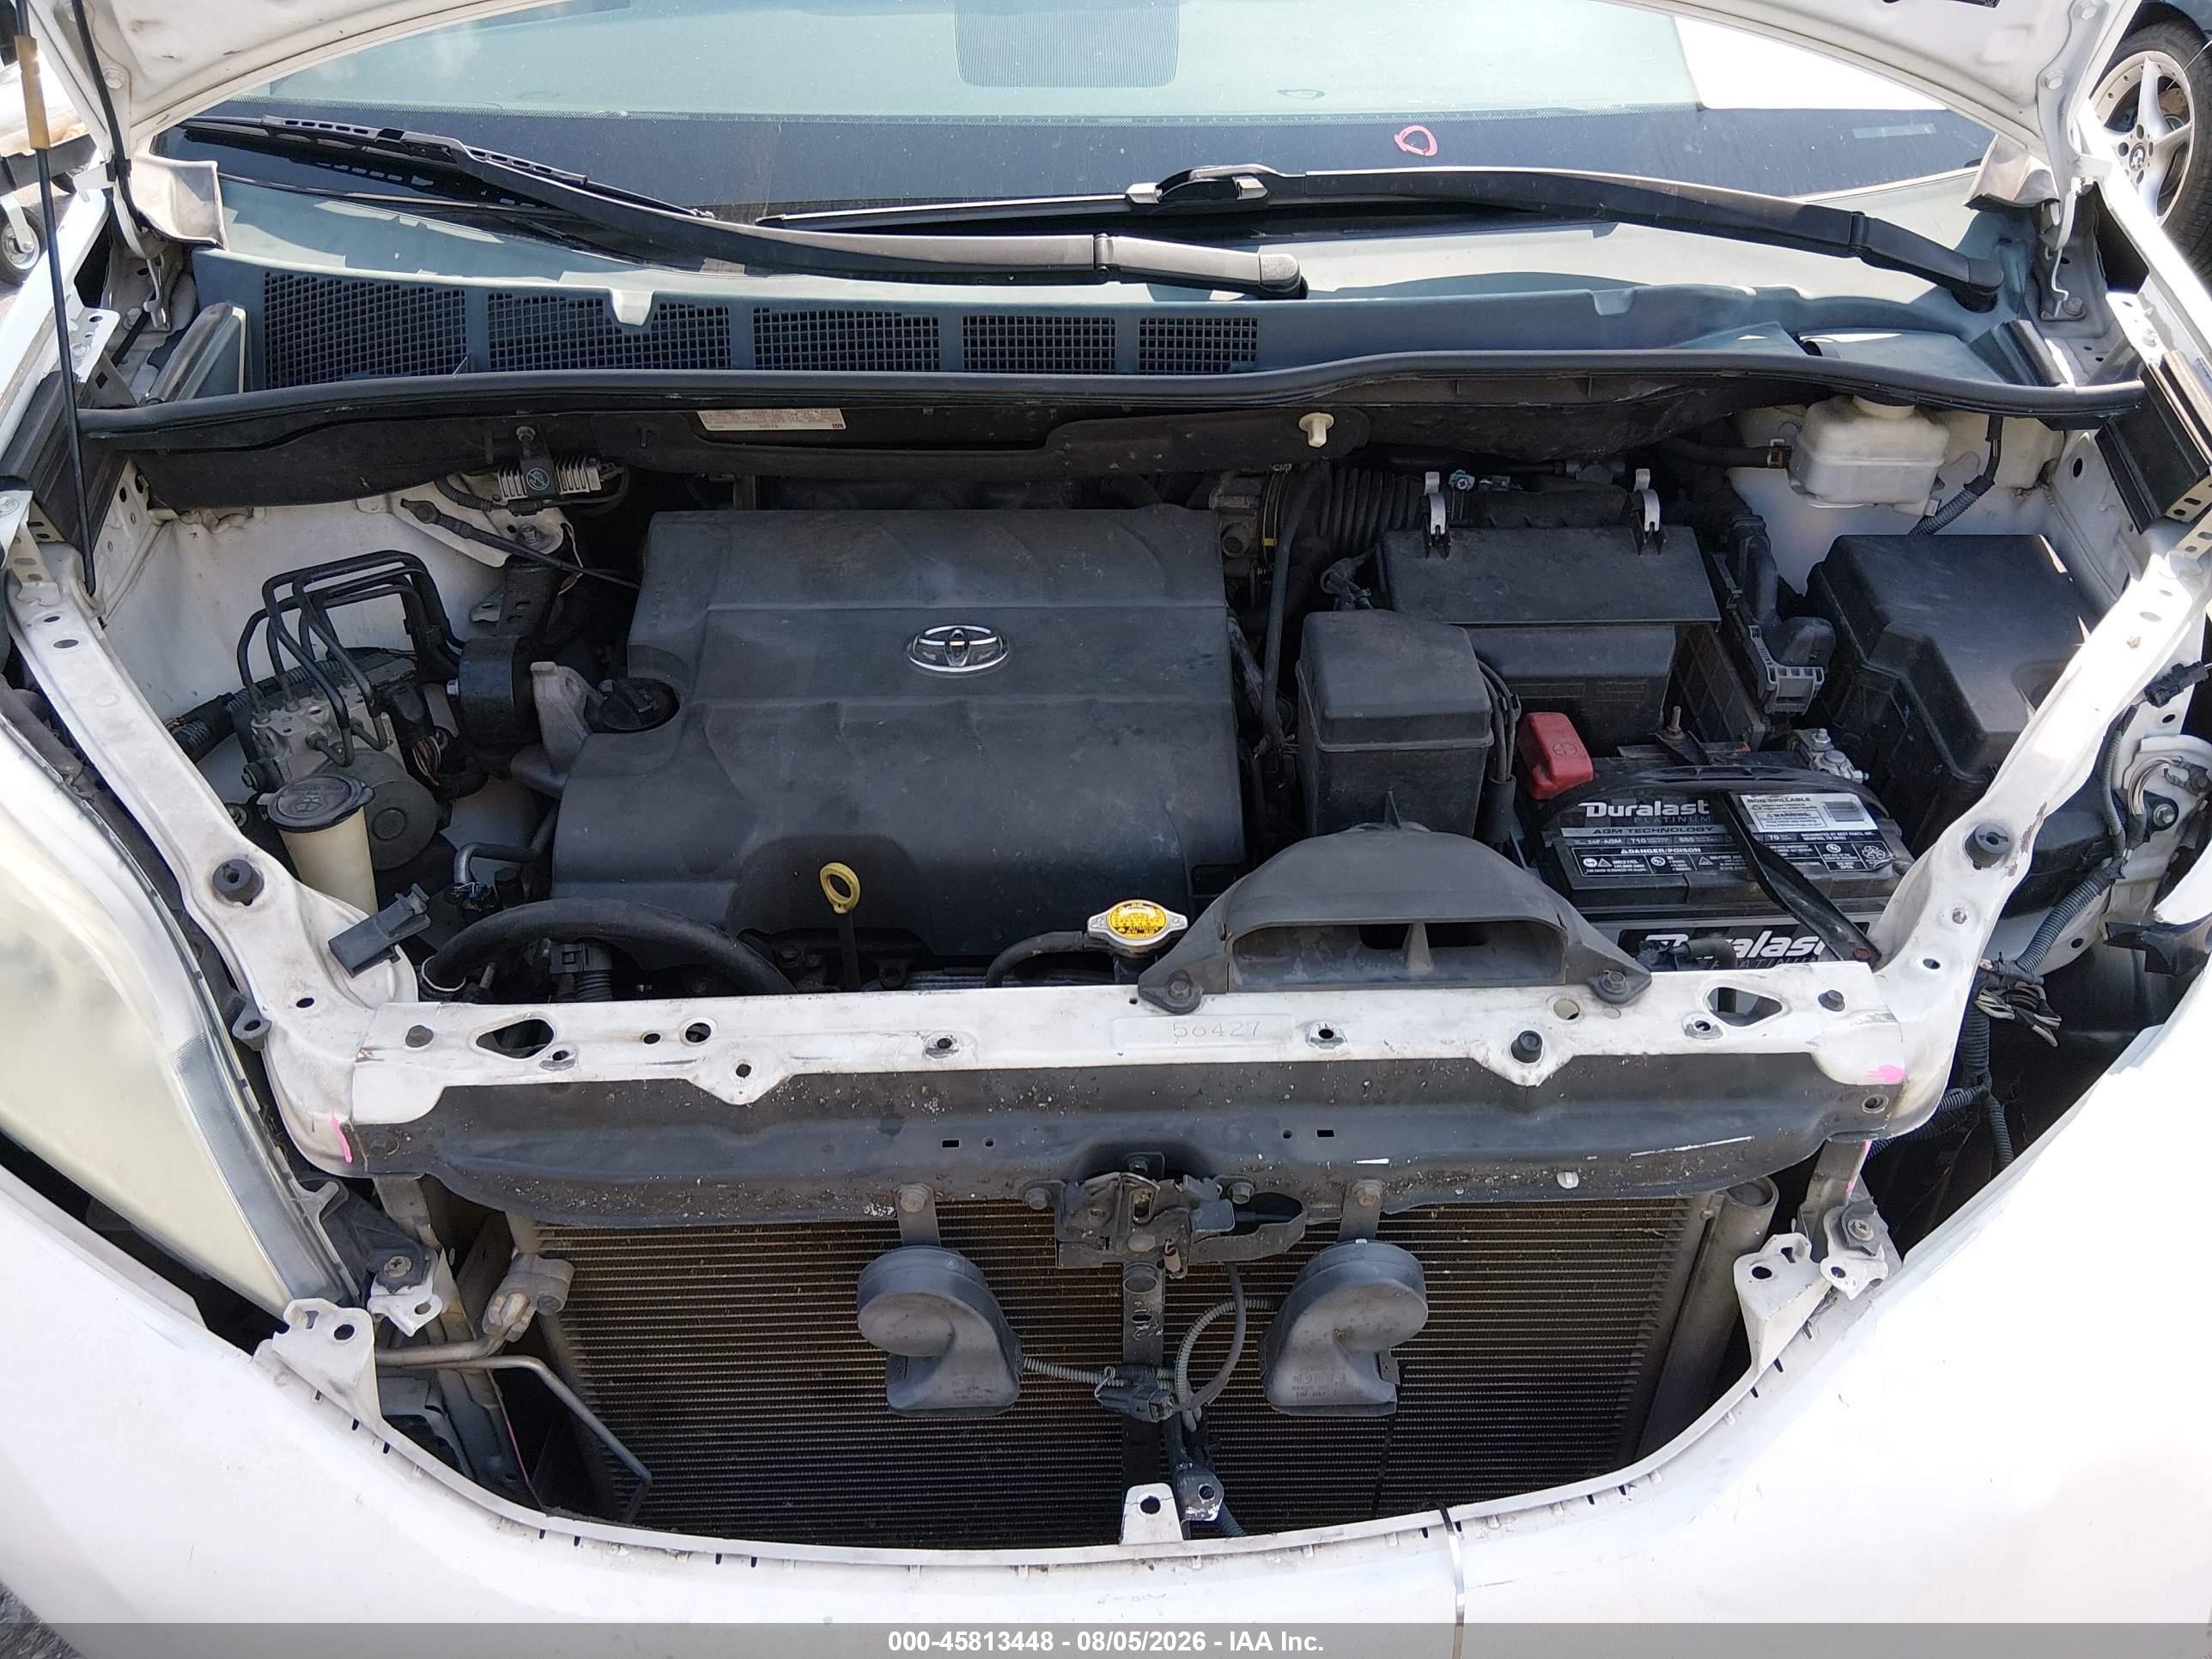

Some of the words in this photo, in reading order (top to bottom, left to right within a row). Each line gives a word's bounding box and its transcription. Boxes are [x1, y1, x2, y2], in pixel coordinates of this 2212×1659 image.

[1577, 799, 1711, 817] Duralast
[1633, 816, 1711, 824] PLATINUM
[1628, 826, 1716, 835] TECHNOLOGY
[1645, 931, 1826, 960] alas
[1173, 1021, 1261, 1038] 56427
